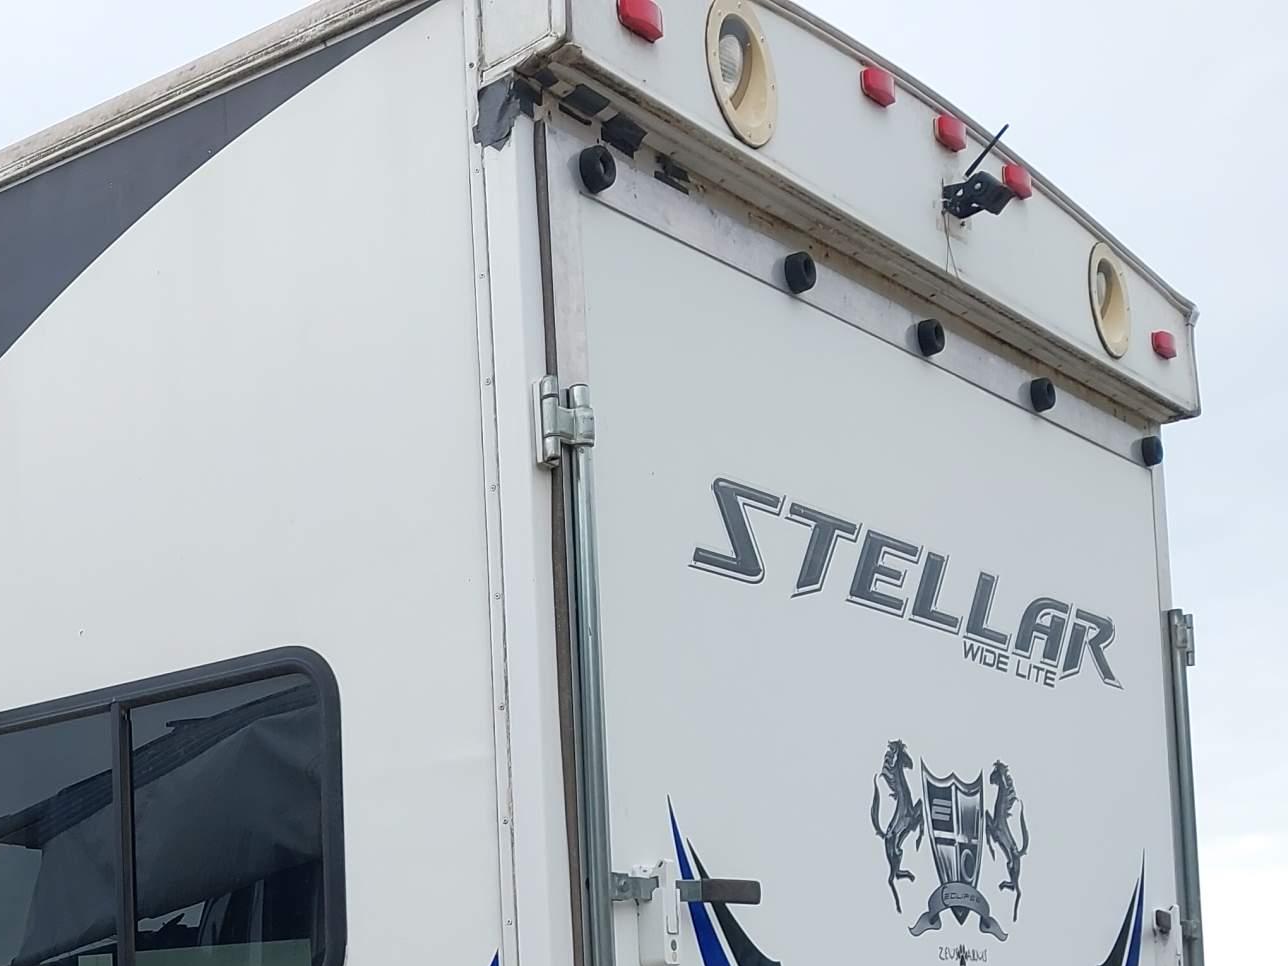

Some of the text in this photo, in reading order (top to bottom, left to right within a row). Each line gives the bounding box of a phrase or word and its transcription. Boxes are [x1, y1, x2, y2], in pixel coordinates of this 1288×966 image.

[687, 476, 1124, 690] STELLAR
[963, 640, 1057, 688] WIDE LITE
